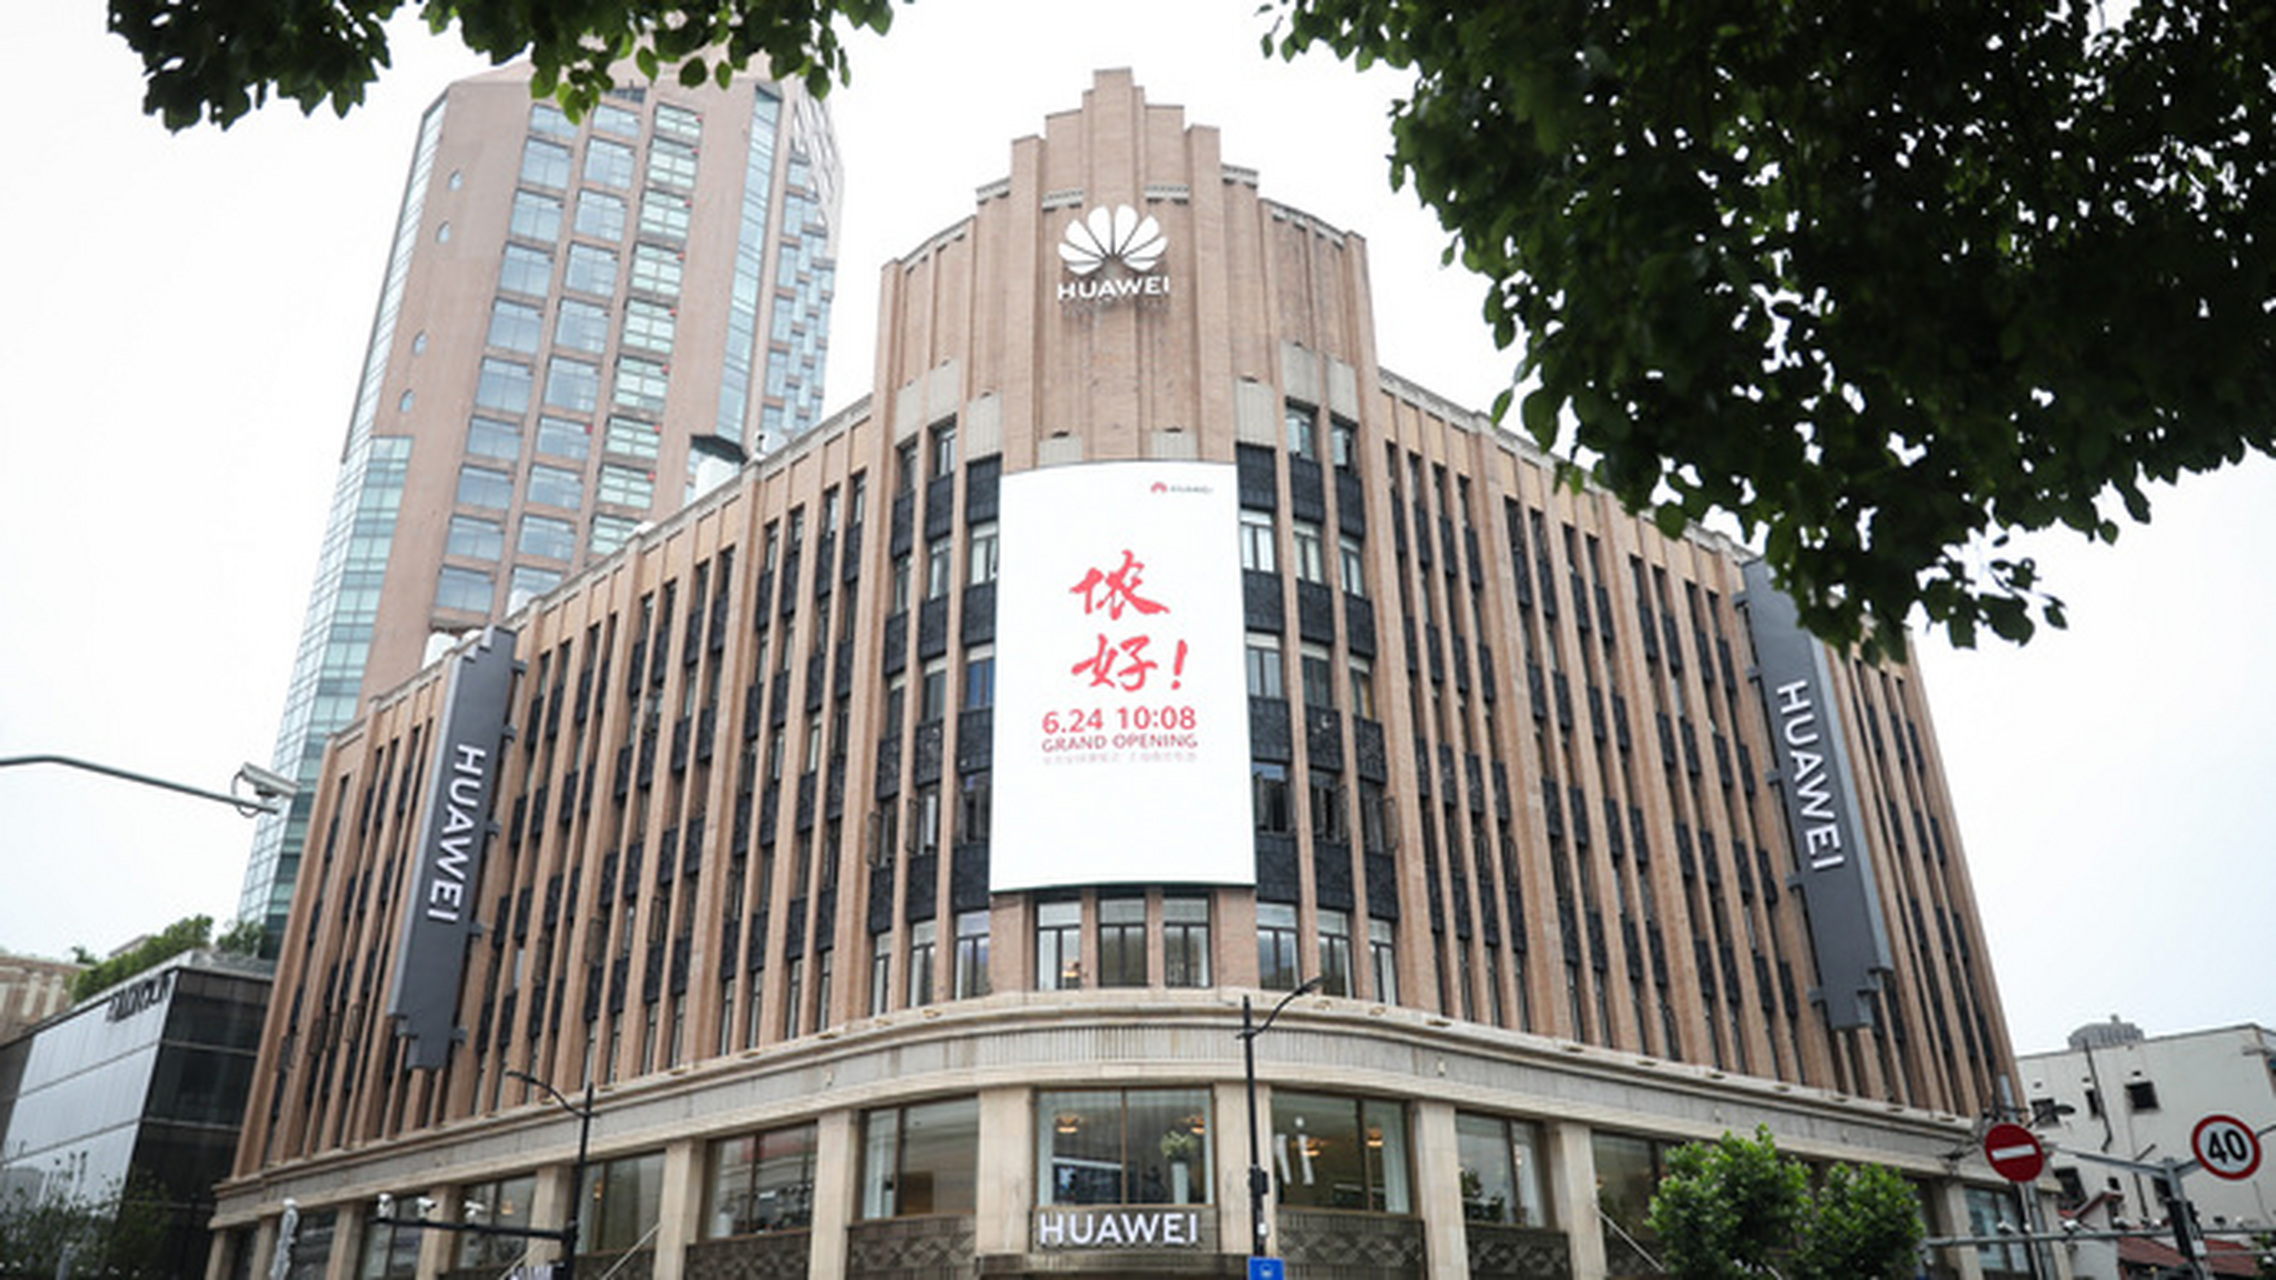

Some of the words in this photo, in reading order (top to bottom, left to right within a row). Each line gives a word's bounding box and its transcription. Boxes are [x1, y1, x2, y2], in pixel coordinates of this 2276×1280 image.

[1057, 275, 1170, 301] HUAWEI
[1069, 549, 1172, 621] 侬
[1041, 707, 1104, 735] 6.24
[1116, 705, 1198, 731] 10:08
[1041, 734, 1107, 753] GRAND
[1111, 732, 1199, 750] OPENING
[1776, 679, 1845, 870] HUAWEI
[427, 743, 487, 922] HUAWEI
[2208, 1128, 2247, 1165] 40
[1039, 1212, 1198, 1245] HUAWEI
